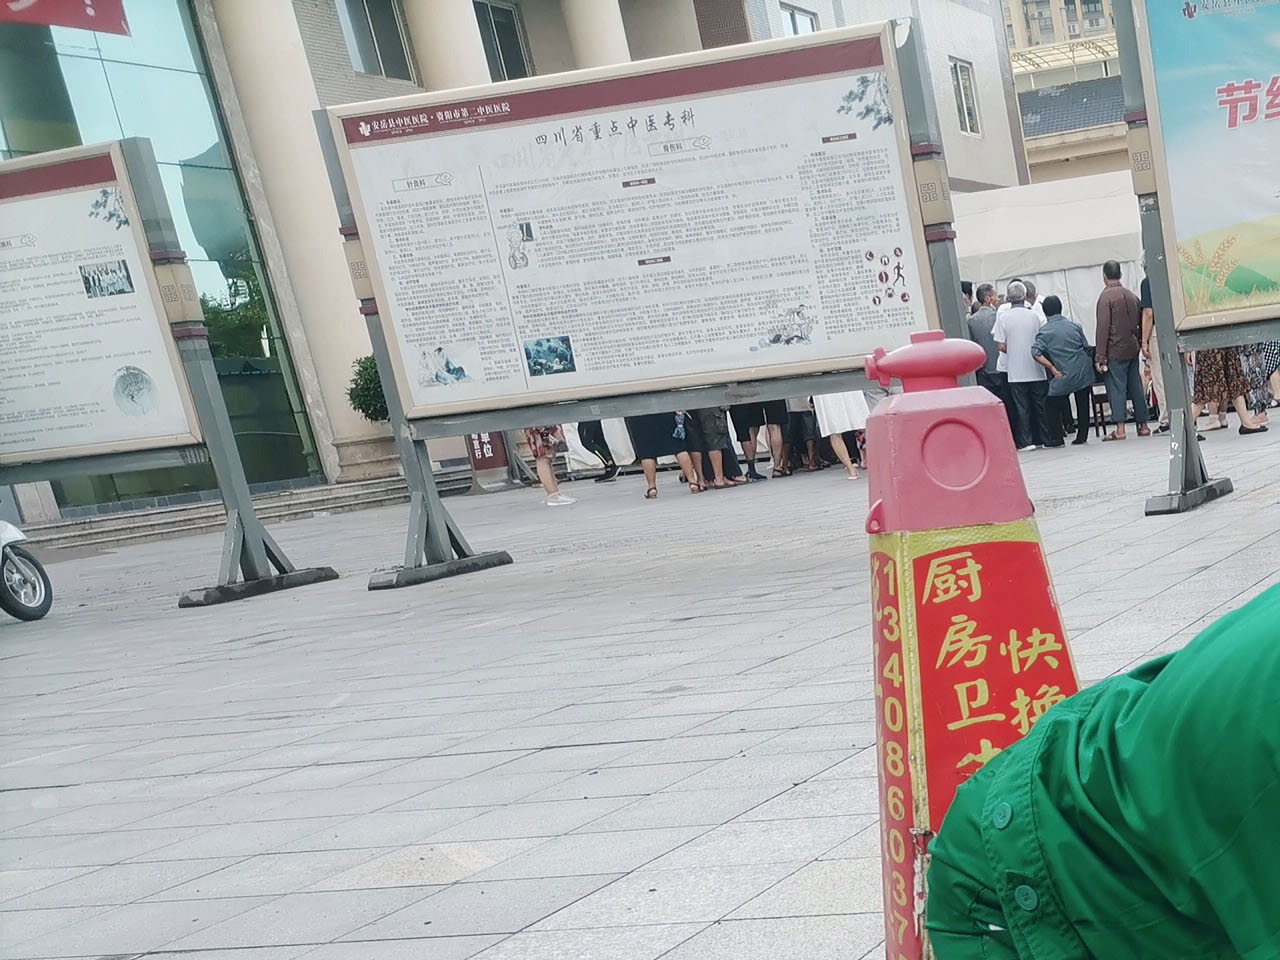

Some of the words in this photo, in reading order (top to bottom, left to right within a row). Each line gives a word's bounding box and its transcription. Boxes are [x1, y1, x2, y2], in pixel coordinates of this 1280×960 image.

[535, 107, 695, 146] 四川省重点中医专科
